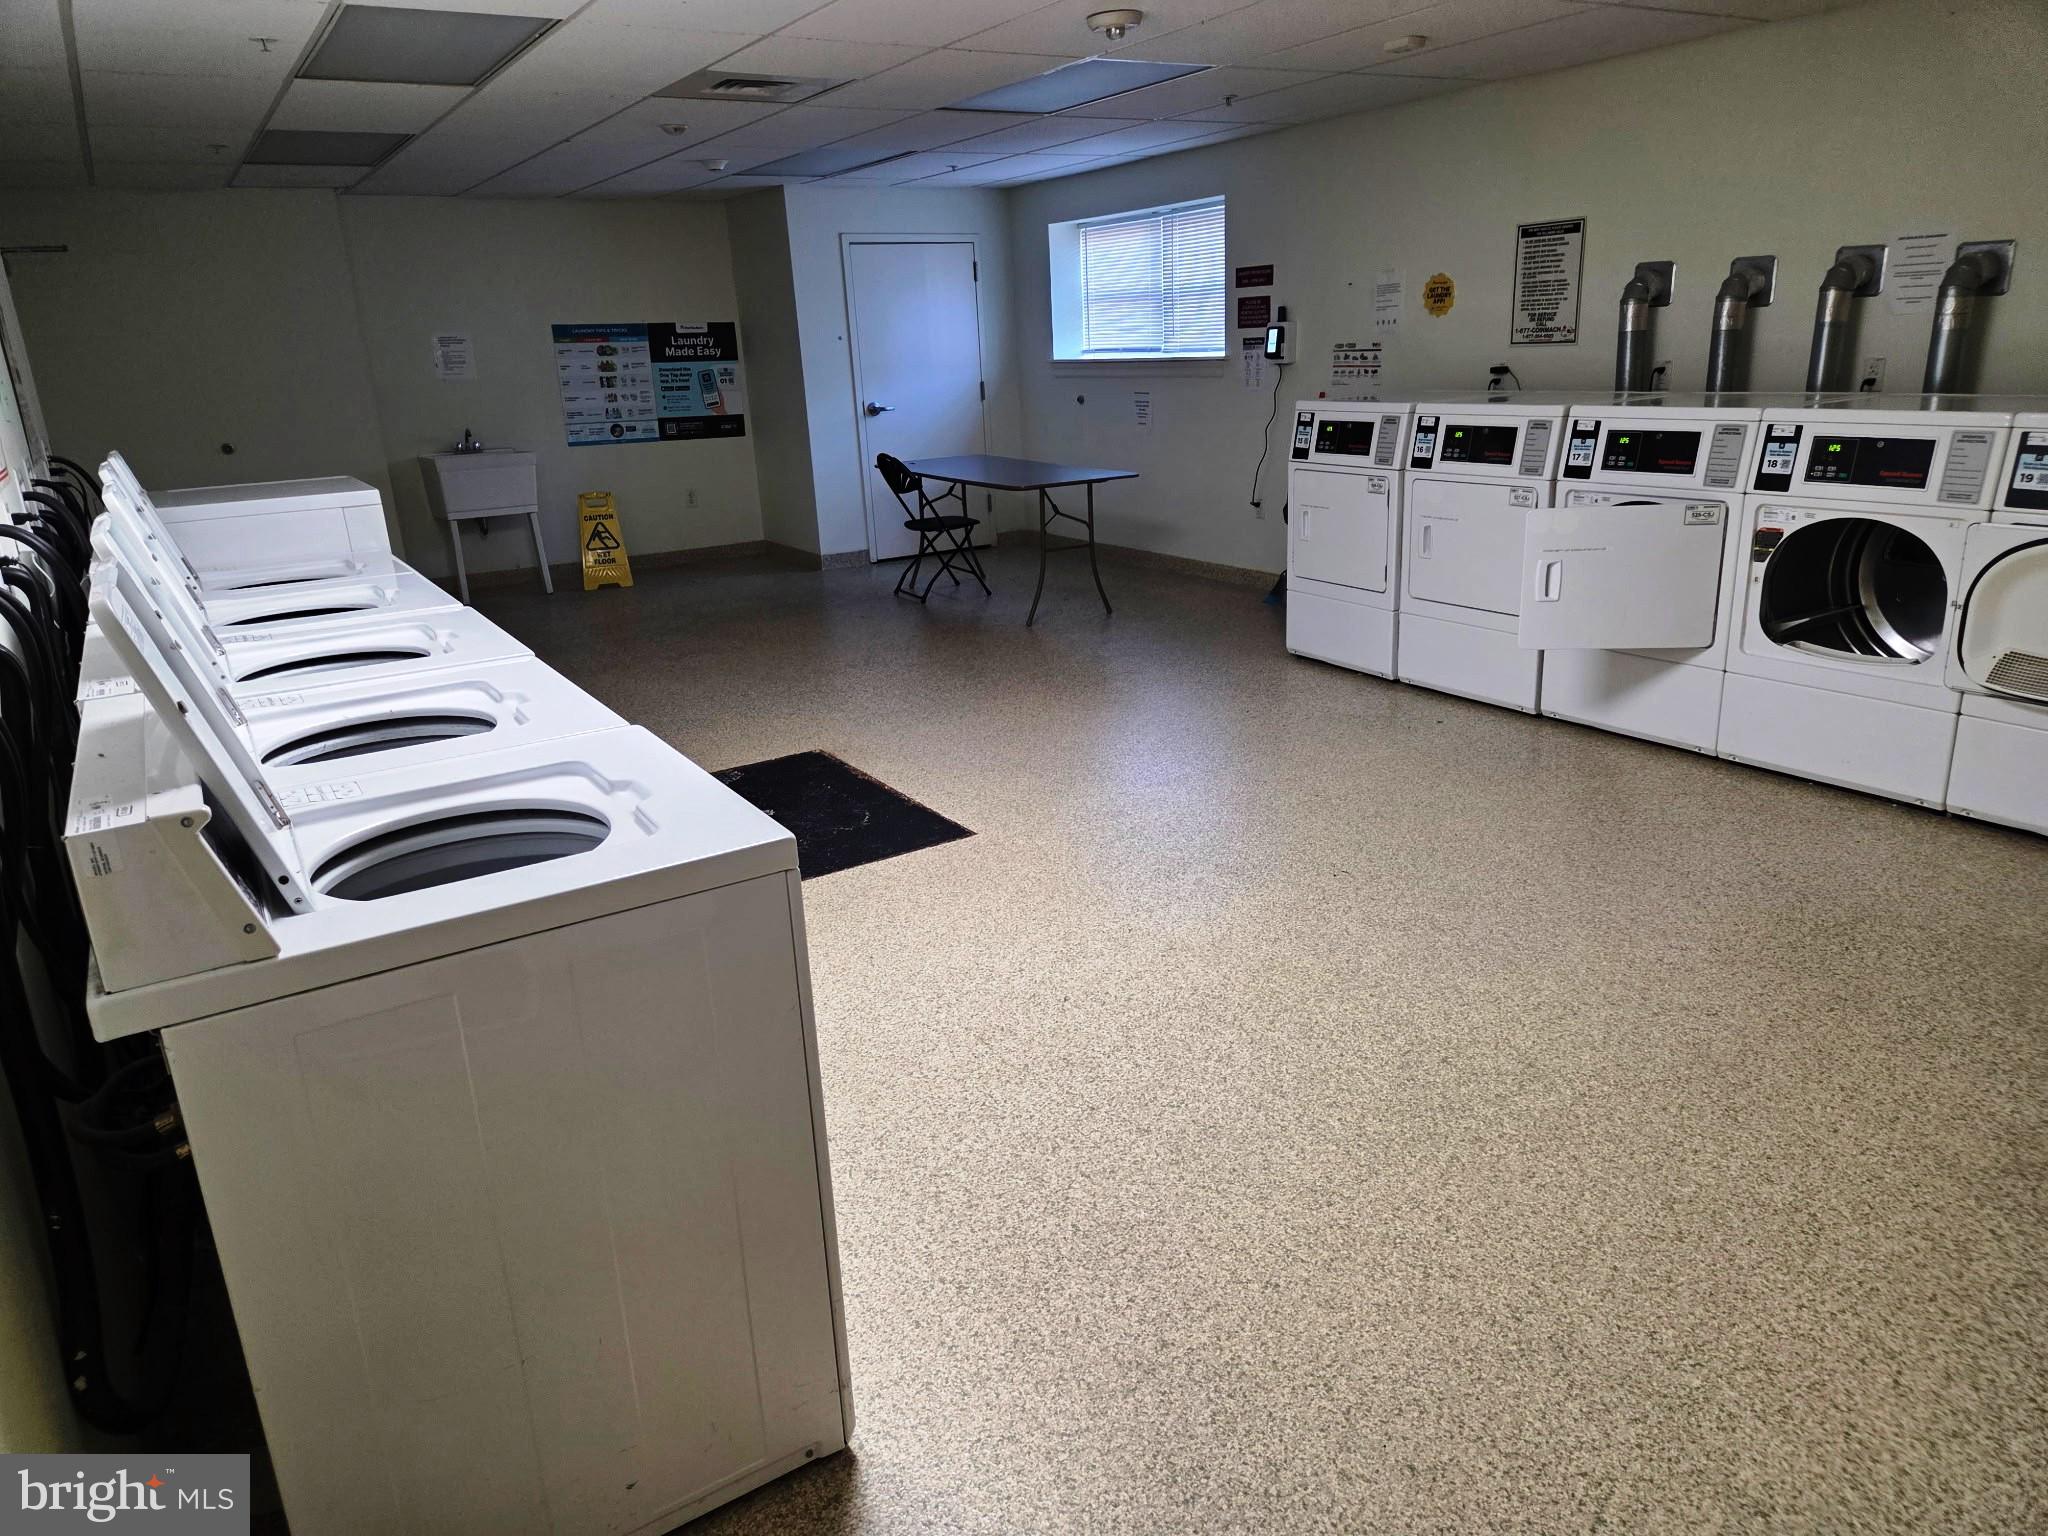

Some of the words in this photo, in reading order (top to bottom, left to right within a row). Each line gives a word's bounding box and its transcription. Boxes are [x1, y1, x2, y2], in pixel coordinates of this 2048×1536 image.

[671, 335, 714, 347] Laundry
[665, 346, 695, 357] Made
[696, 346, 721, 357] Easy
[1417, 445, 1424, 453] 16
[1572, 453, 1581, 461] 17
[1767, 459, 1778, 468] 18
[2020, 473, 2034, 483] 19
[583, 514, 614, 522] CAUTION
